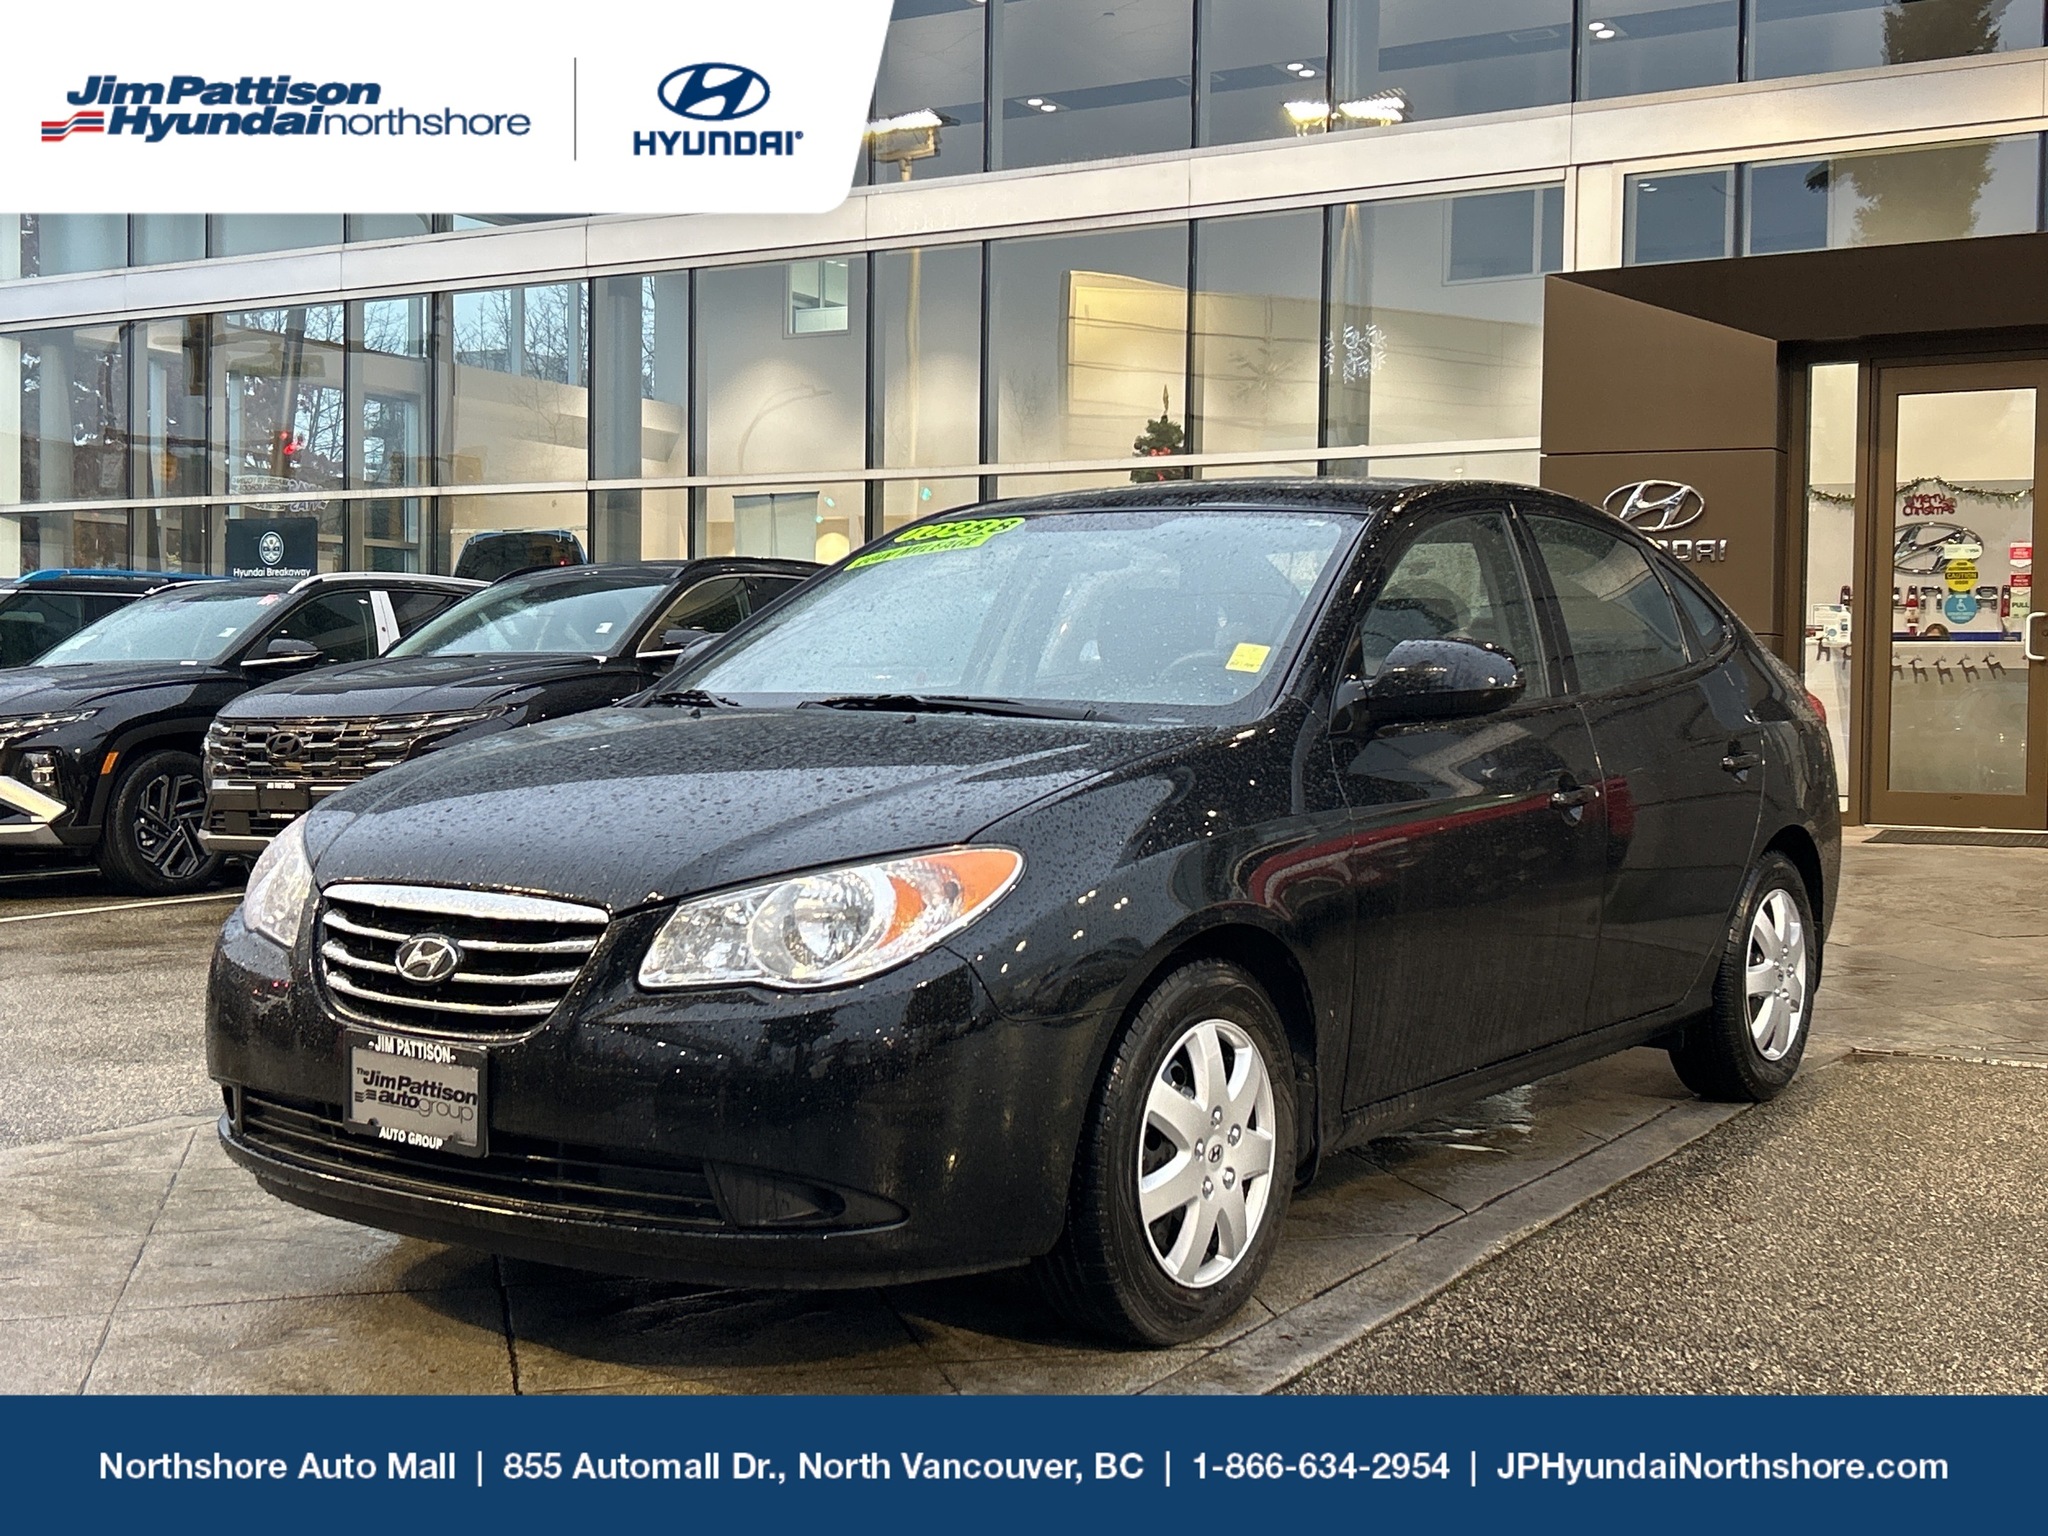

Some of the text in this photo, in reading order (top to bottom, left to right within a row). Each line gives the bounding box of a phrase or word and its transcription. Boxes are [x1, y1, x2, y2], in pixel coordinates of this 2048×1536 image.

[233, 567, 311, 578] Hyundai Breakaway
[375, 1034, 451, 1064] JIM PATTISON
[355, 1066, 370, 1077] The
[378, 1126, 444, 1150] AUTO GROUP
